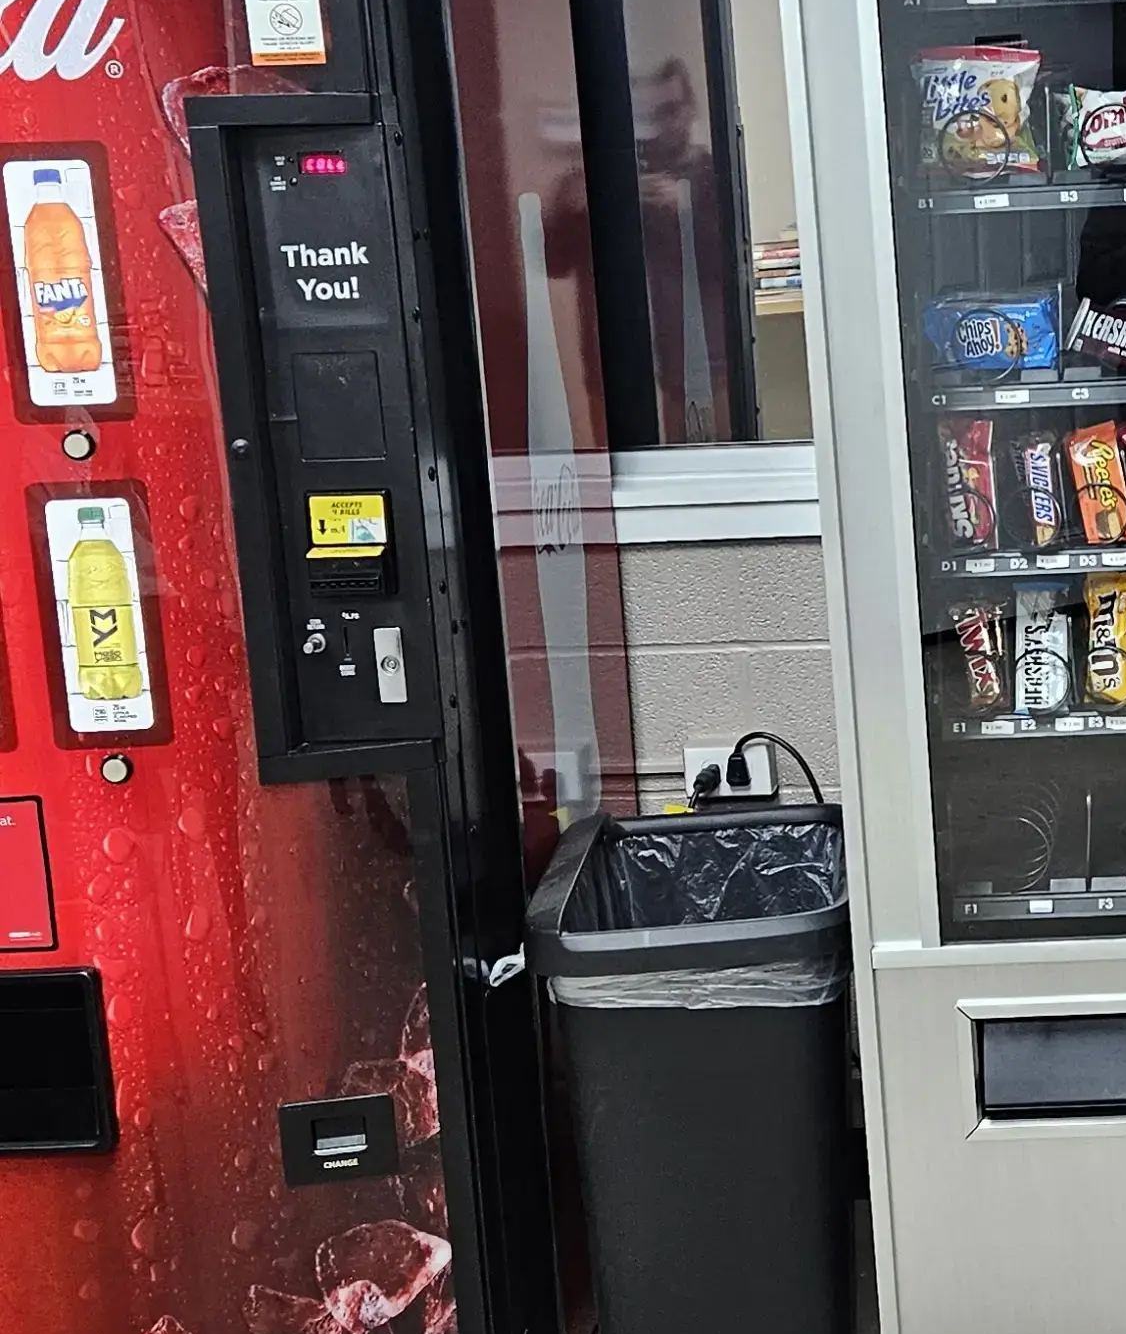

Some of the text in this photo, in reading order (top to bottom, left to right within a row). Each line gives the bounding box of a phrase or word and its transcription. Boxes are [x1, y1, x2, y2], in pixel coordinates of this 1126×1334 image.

[1060, 190, 1079, 202] B3
[280, 241, 370, 268] Thank
[296, 276, 360, 301] You!
[958, 318, 992, 343] Chips
[932, 394, 947, 406] C1
[1071, 387, 1090, 400] C3
[1090, 439, 1117, 509] Reese's
[1030, 453, 1055, 525] SNICERS
[942, 560, 957, 571] D1
[1010, 557, 1028, 570] D2
[1079, 554, 1097, 567] D3
[952, 722, 966, 733] E1
[1021, 719, 1036, 731] E2
[1088, 716, 1103, 729] E3
[964, 903, 978, 914] F1
[1098, 897, 1113, 910] F3
